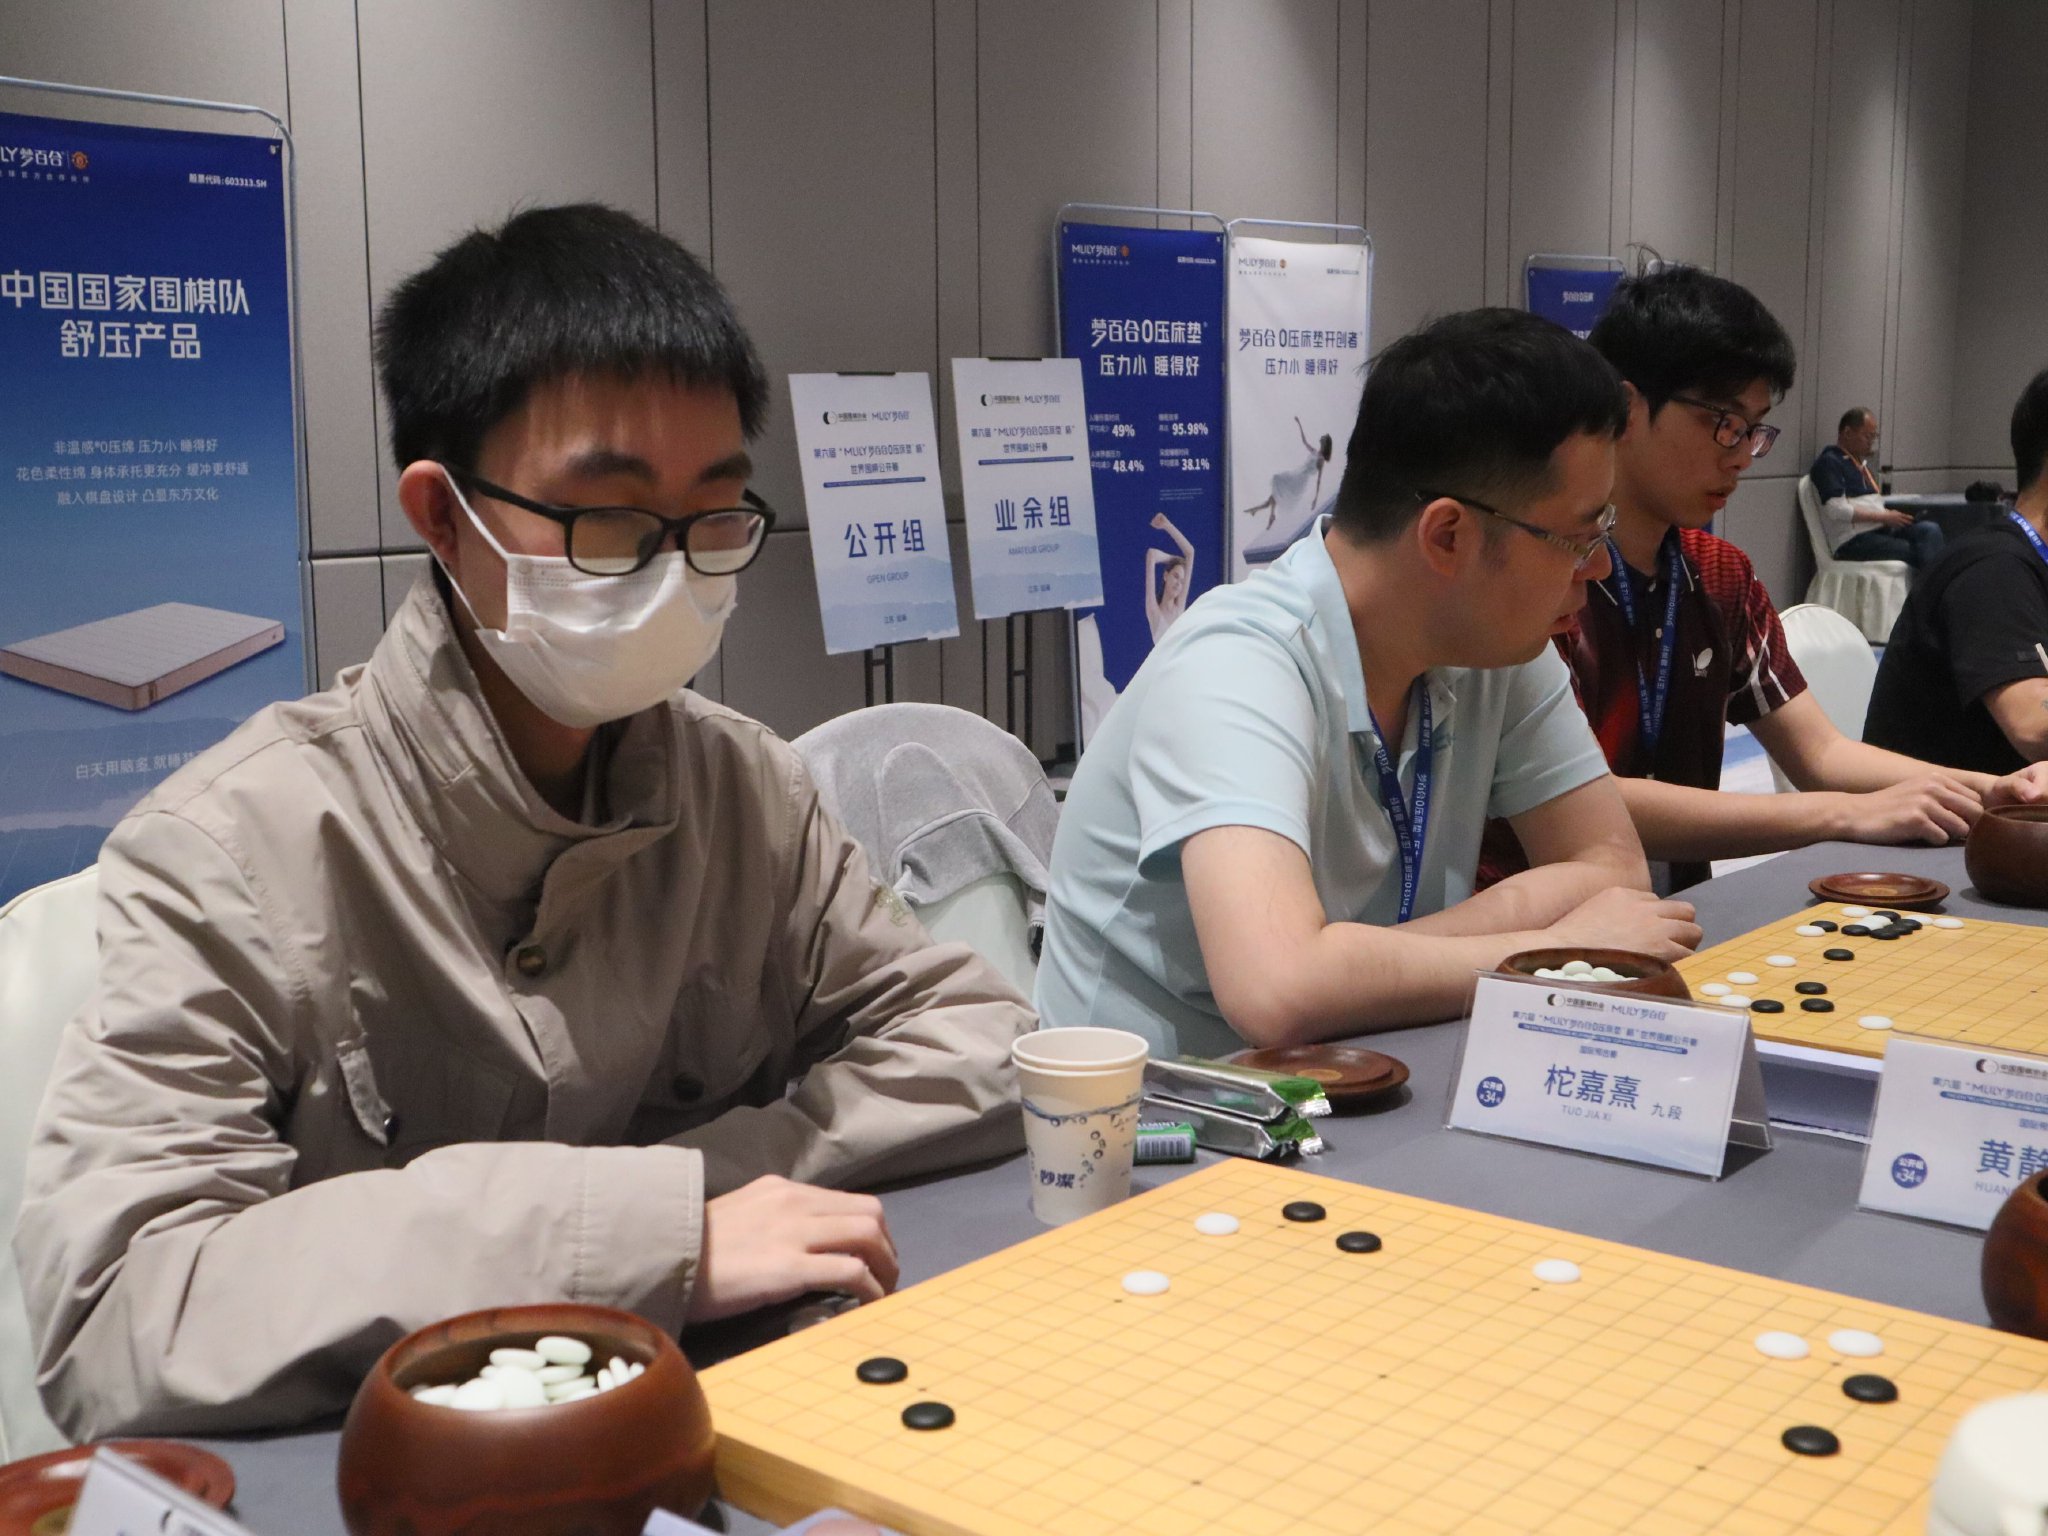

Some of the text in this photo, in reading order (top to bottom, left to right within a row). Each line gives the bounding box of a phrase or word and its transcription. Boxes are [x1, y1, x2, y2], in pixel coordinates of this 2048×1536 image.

[1, 269, 250, 315] 中国国家围棋队
[60, 319, 201, 359] 舒压产品
[1100, 354, 1199, 376] 压力小 睡得好
[1265, 358, 1338, 375] 压力小 睡得好
[1112, 424, 1135, 437] 49%
[1172, 423, 1208, 435] 95.98%
[138, 439, 177, 453] 压力小
[180, 438, 218, 453] 睡得好
[90, 464, 181, 480] 身体承托更充分
[1113, 459, 1144, 473] 48.4%
[1182, 458, 1210, 471] 38.1%
[995, 496, 1071, 531] 业余组
[844, 519, 925, 558] 公开组
[1651, 1102, 1683, 1121] 九段
